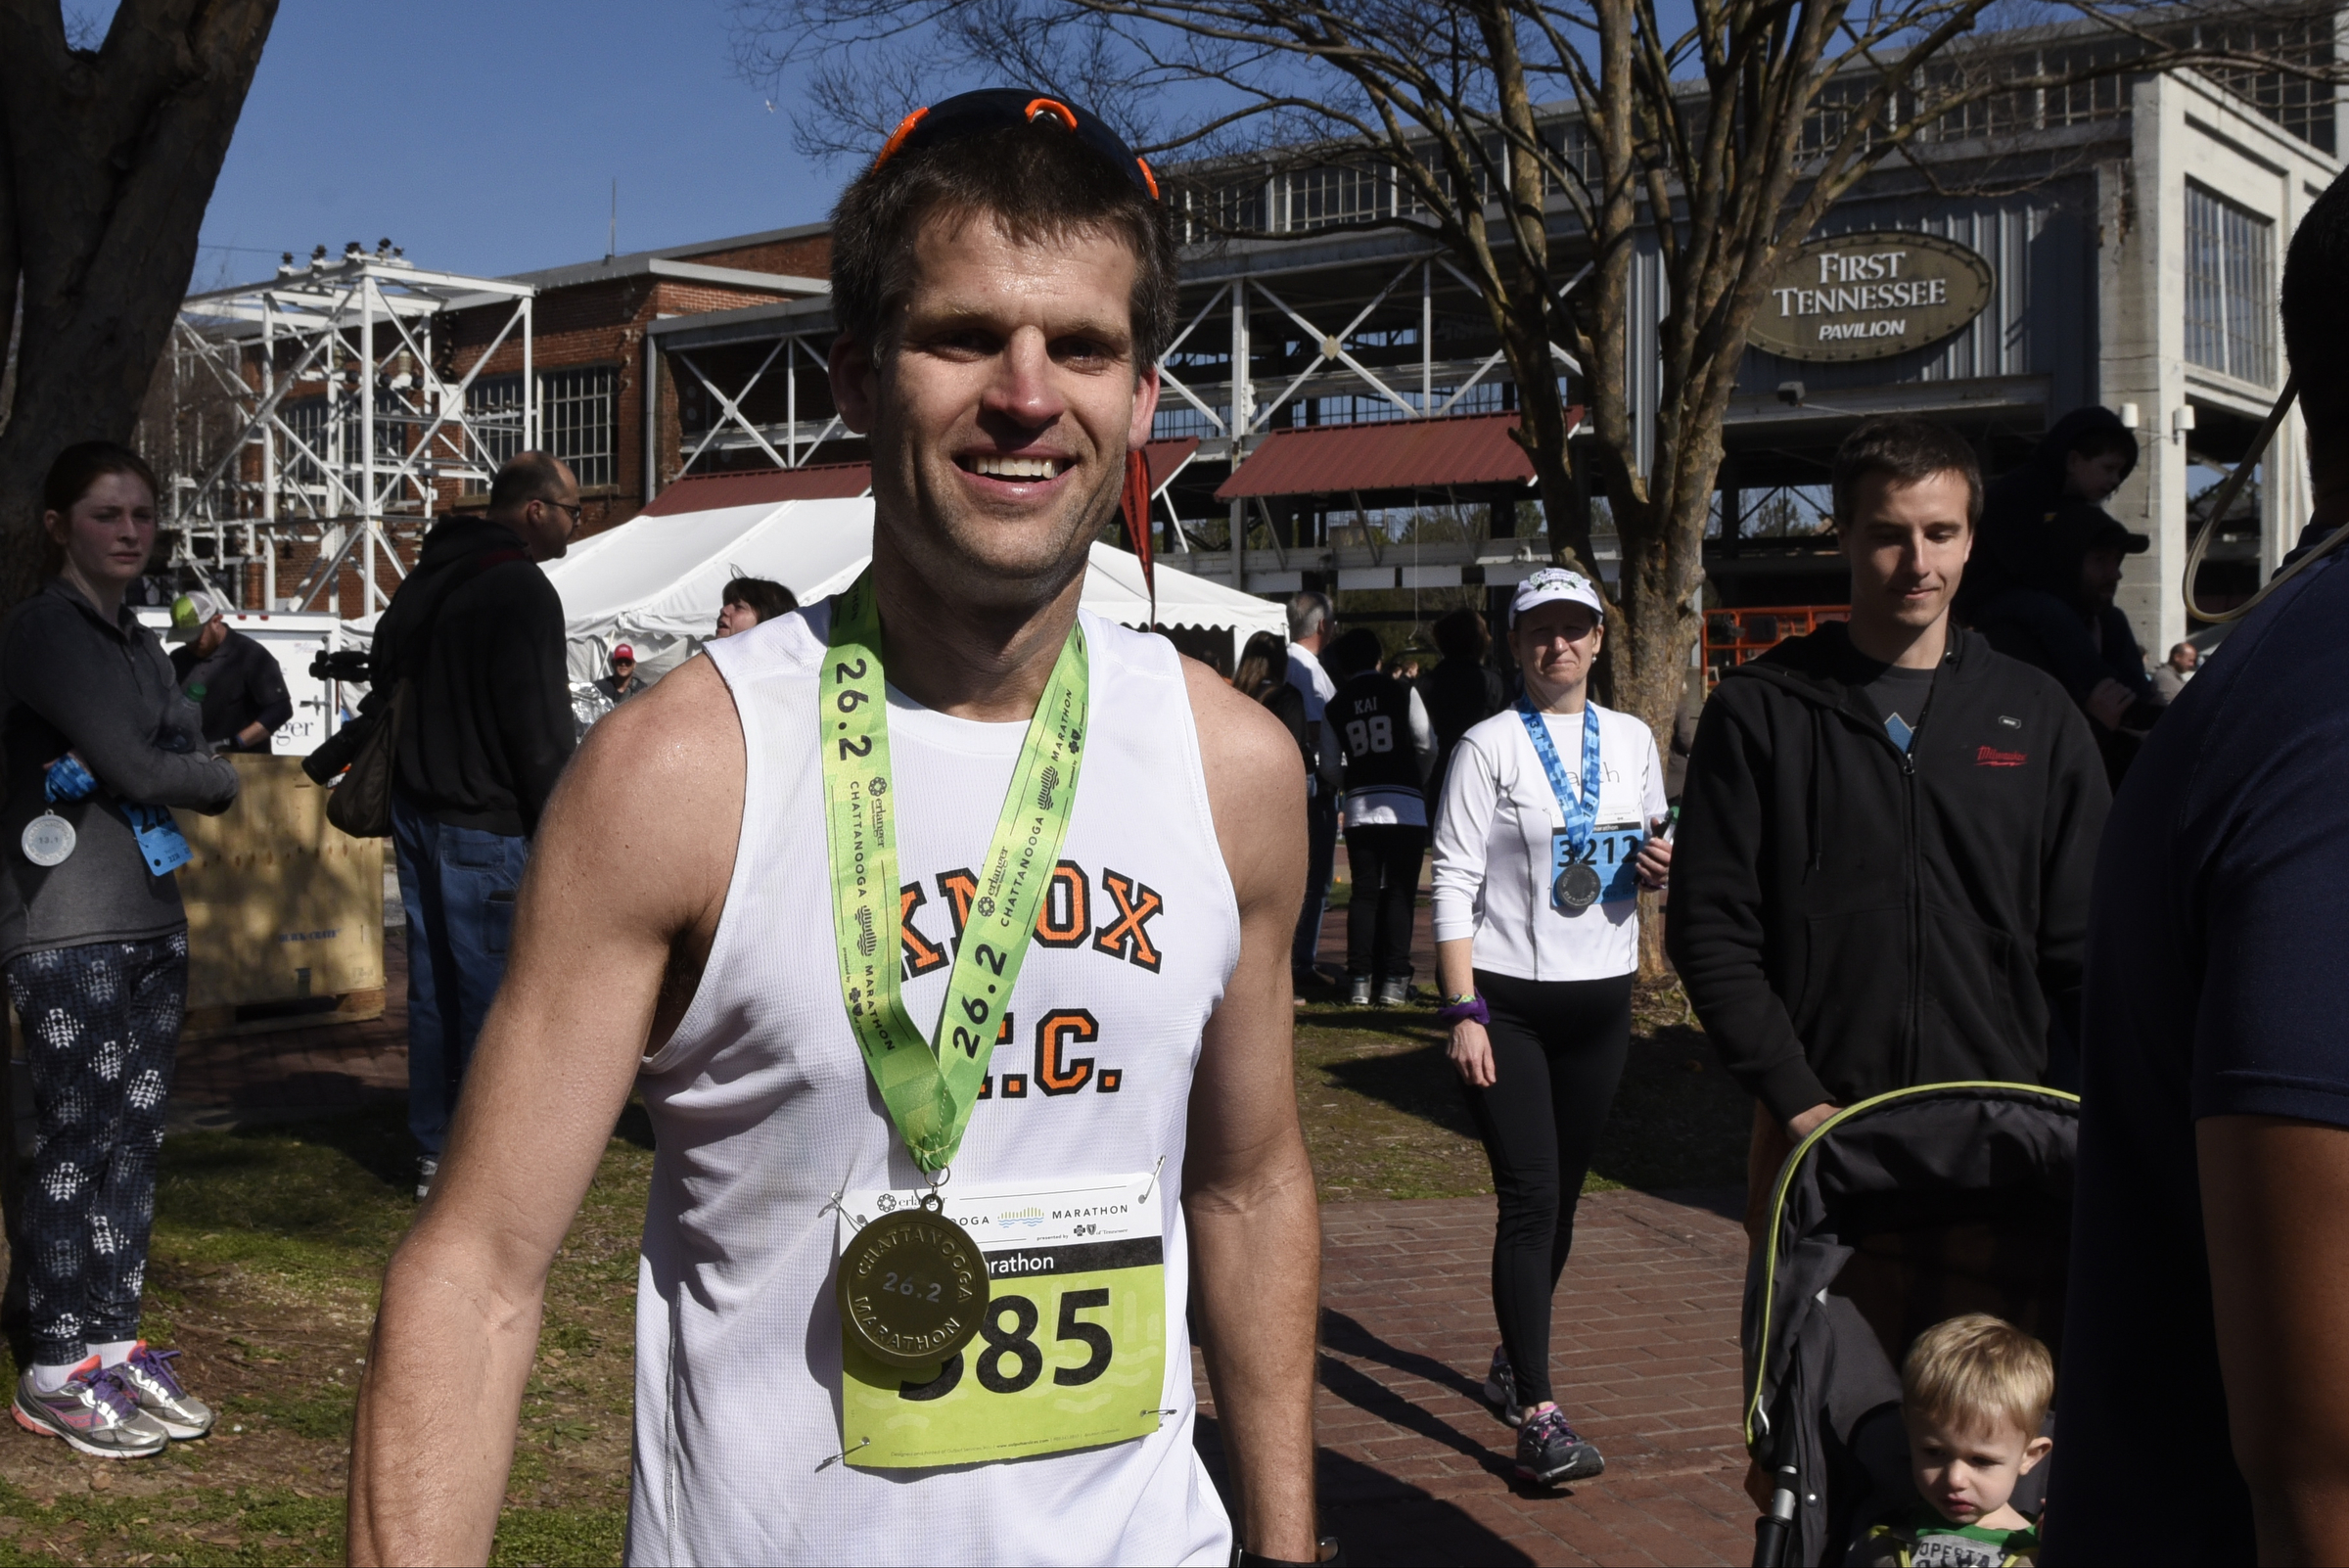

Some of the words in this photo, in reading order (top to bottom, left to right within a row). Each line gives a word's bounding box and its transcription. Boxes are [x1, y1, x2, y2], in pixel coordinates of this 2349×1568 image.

[1819, 251, 1907, 284] FIRST
[1773, 278, 1947, 317] TENNESSEE
[1818, 319, 1907, 341] PAVILION
[836, 658, 872, 761] 26.2
[1050, 689, 1073, 762] MARATHON
[1354, 696, 1377, 715] KAI
[1346, 715, 1394, 758] 88
[850, 781, 867, 899] CHATTANOOGA
[873, 798, 887, 849] erlanger
[988, 846, 1009, 898] erlanger
[1000, 816, 1044, 928] CHATTANOOGA
[865, 965, 896, 1050] MARATHON
[952, 943, 1007, 1059] 26.2
[1052, 1204, 1128, 1220] MARATHON
[857, 1226, 973, 1303] CHATTANOOGA
[883, 1272, 942, 1303] 26.2
[854, 1296, 961, 1352] MARATHON
